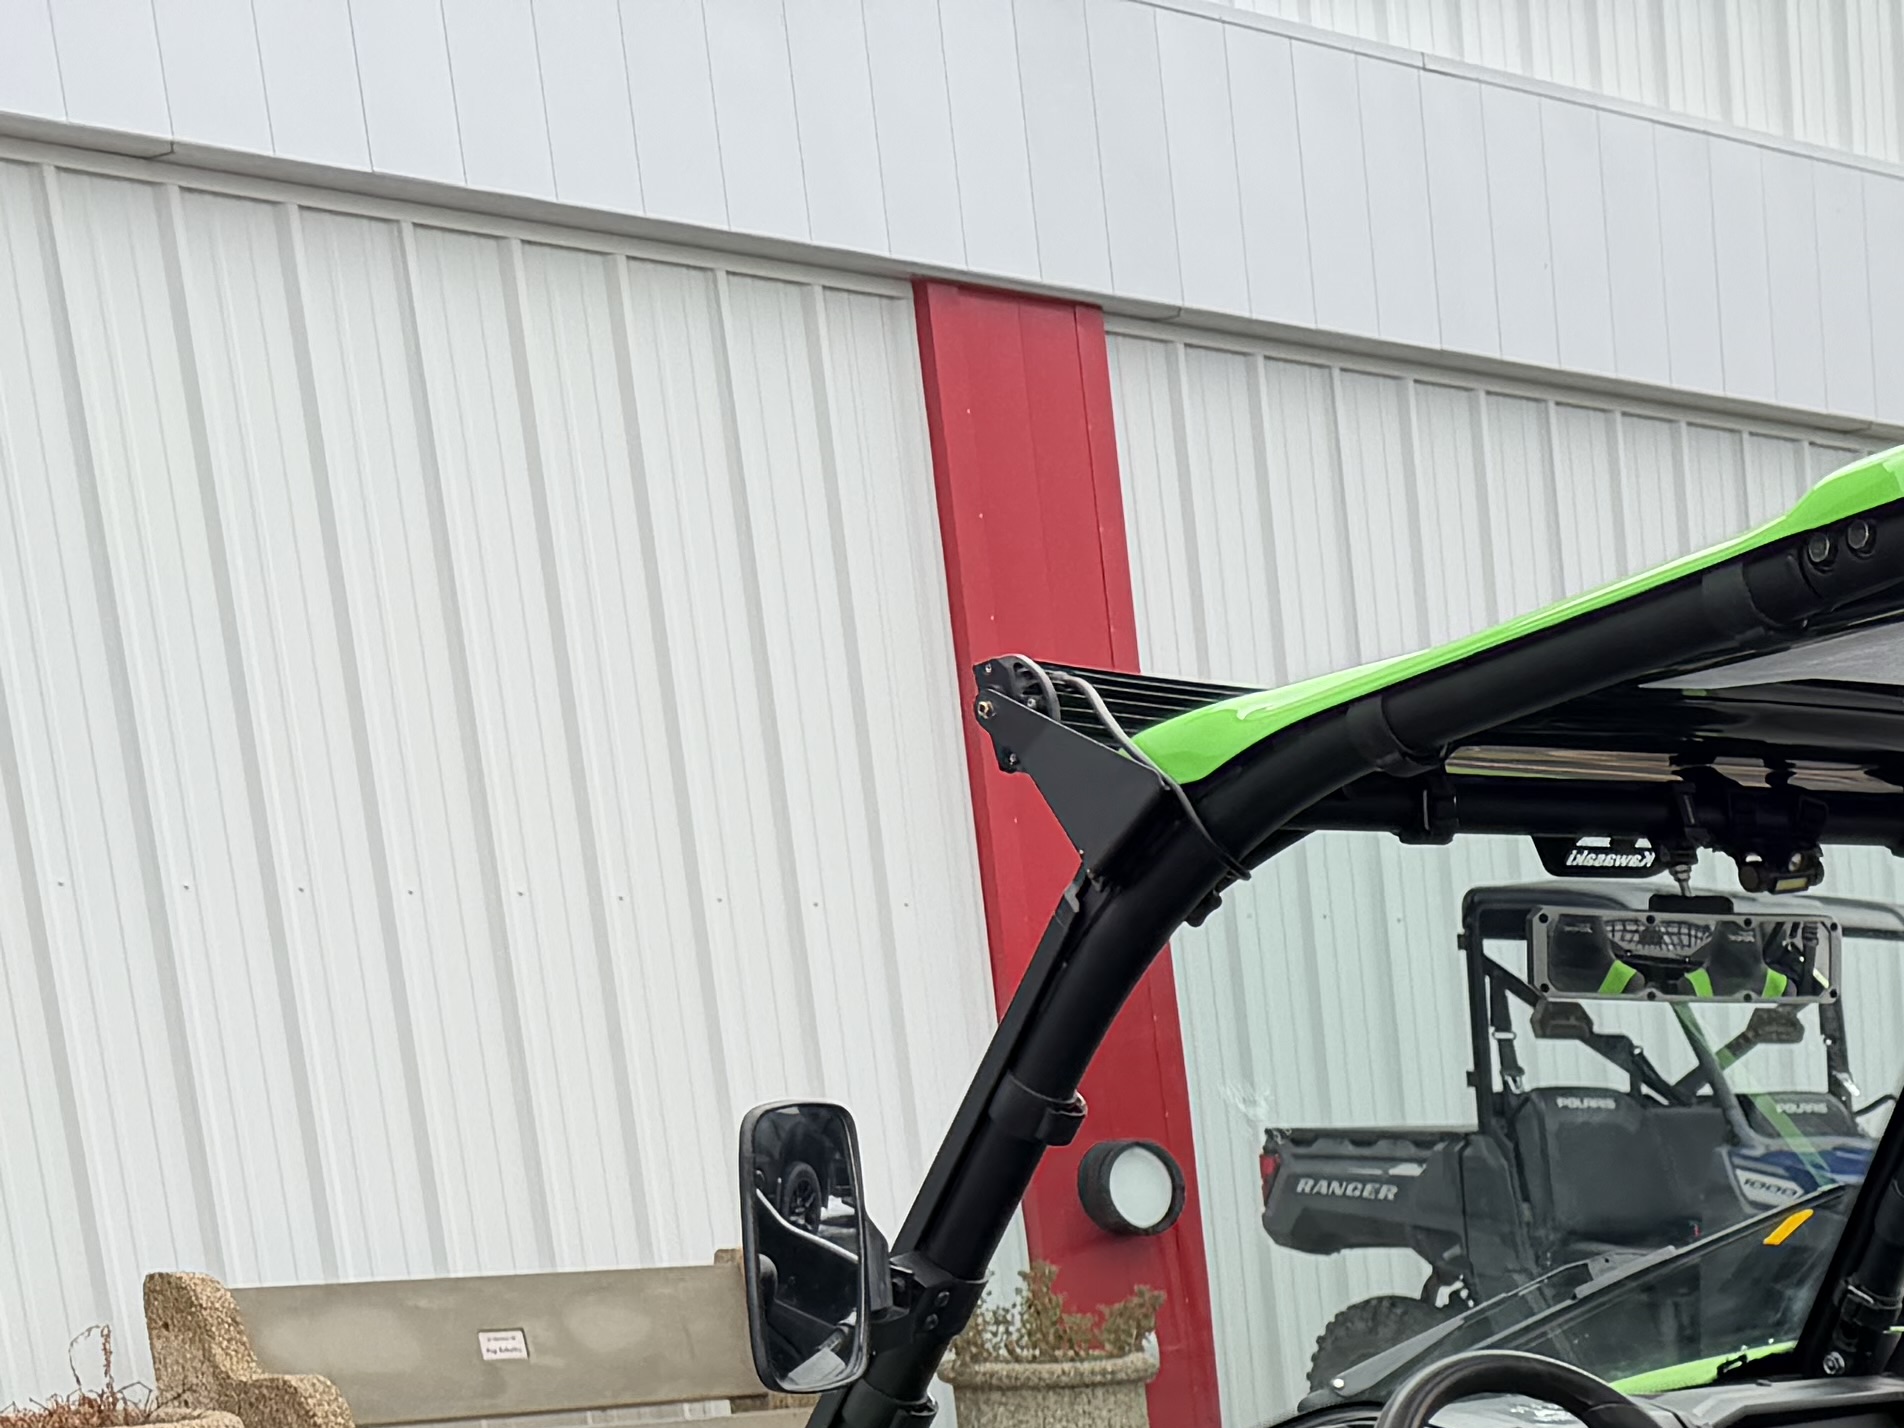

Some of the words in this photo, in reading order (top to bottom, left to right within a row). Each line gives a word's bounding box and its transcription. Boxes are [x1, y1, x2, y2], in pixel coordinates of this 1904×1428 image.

[1556, 1097, 1616, 1110] POLARIS
[1776, 1102, 1828, 1115] POLARIS
[1296, 1177, 1398, 1201] RANGER
[1744, 1177, 1798, 1198] 1000
